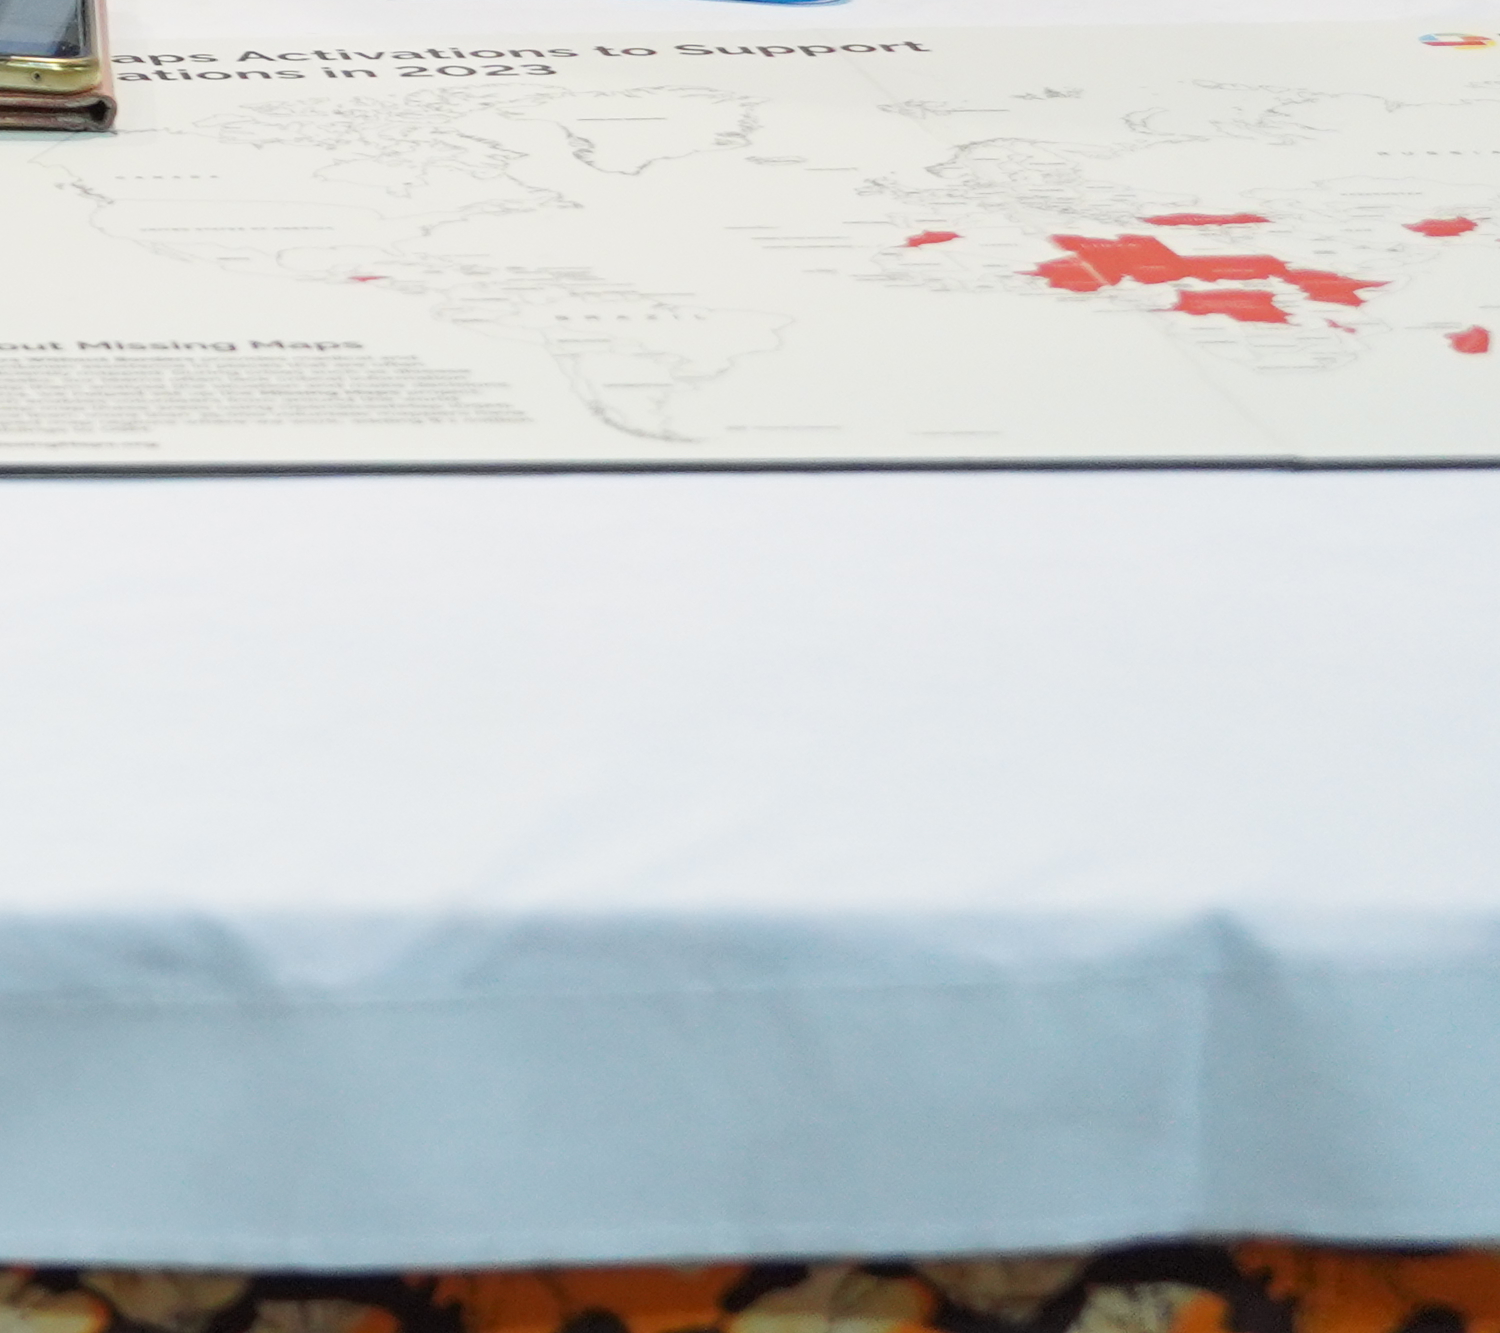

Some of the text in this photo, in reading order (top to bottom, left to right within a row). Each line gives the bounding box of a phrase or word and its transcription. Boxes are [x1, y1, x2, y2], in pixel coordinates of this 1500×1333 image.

[110, 40, 934, 66] aps Activations to Support
[117, 63, 560, 82] ations in 2023
[77, 340, 238, 352] Missing
[249, 339, 364, 352] Maps
